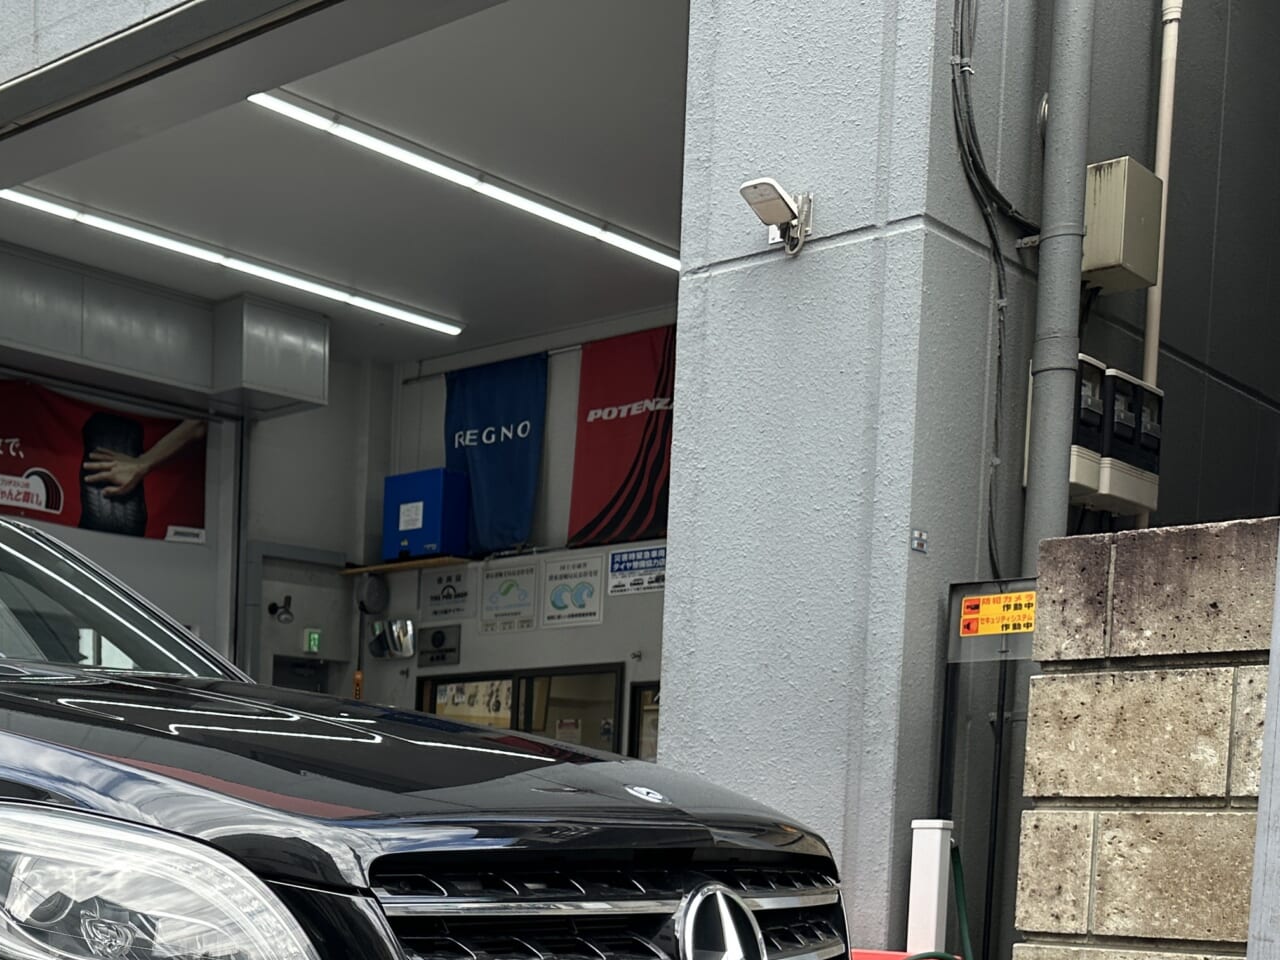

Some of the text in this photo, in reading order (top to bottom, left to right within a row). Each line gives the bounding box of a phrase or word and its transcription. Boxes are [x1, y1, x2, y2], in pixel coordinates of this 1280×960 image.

[586, 397, 675, 422] POTENZ
[454, 420, 531, 448] REGNO
[1002, 602, 1034, 612] 作動中
[980, 614, 1033, 625] セキュリティシステム
[1001, 622, 1033, 632] 作動中
